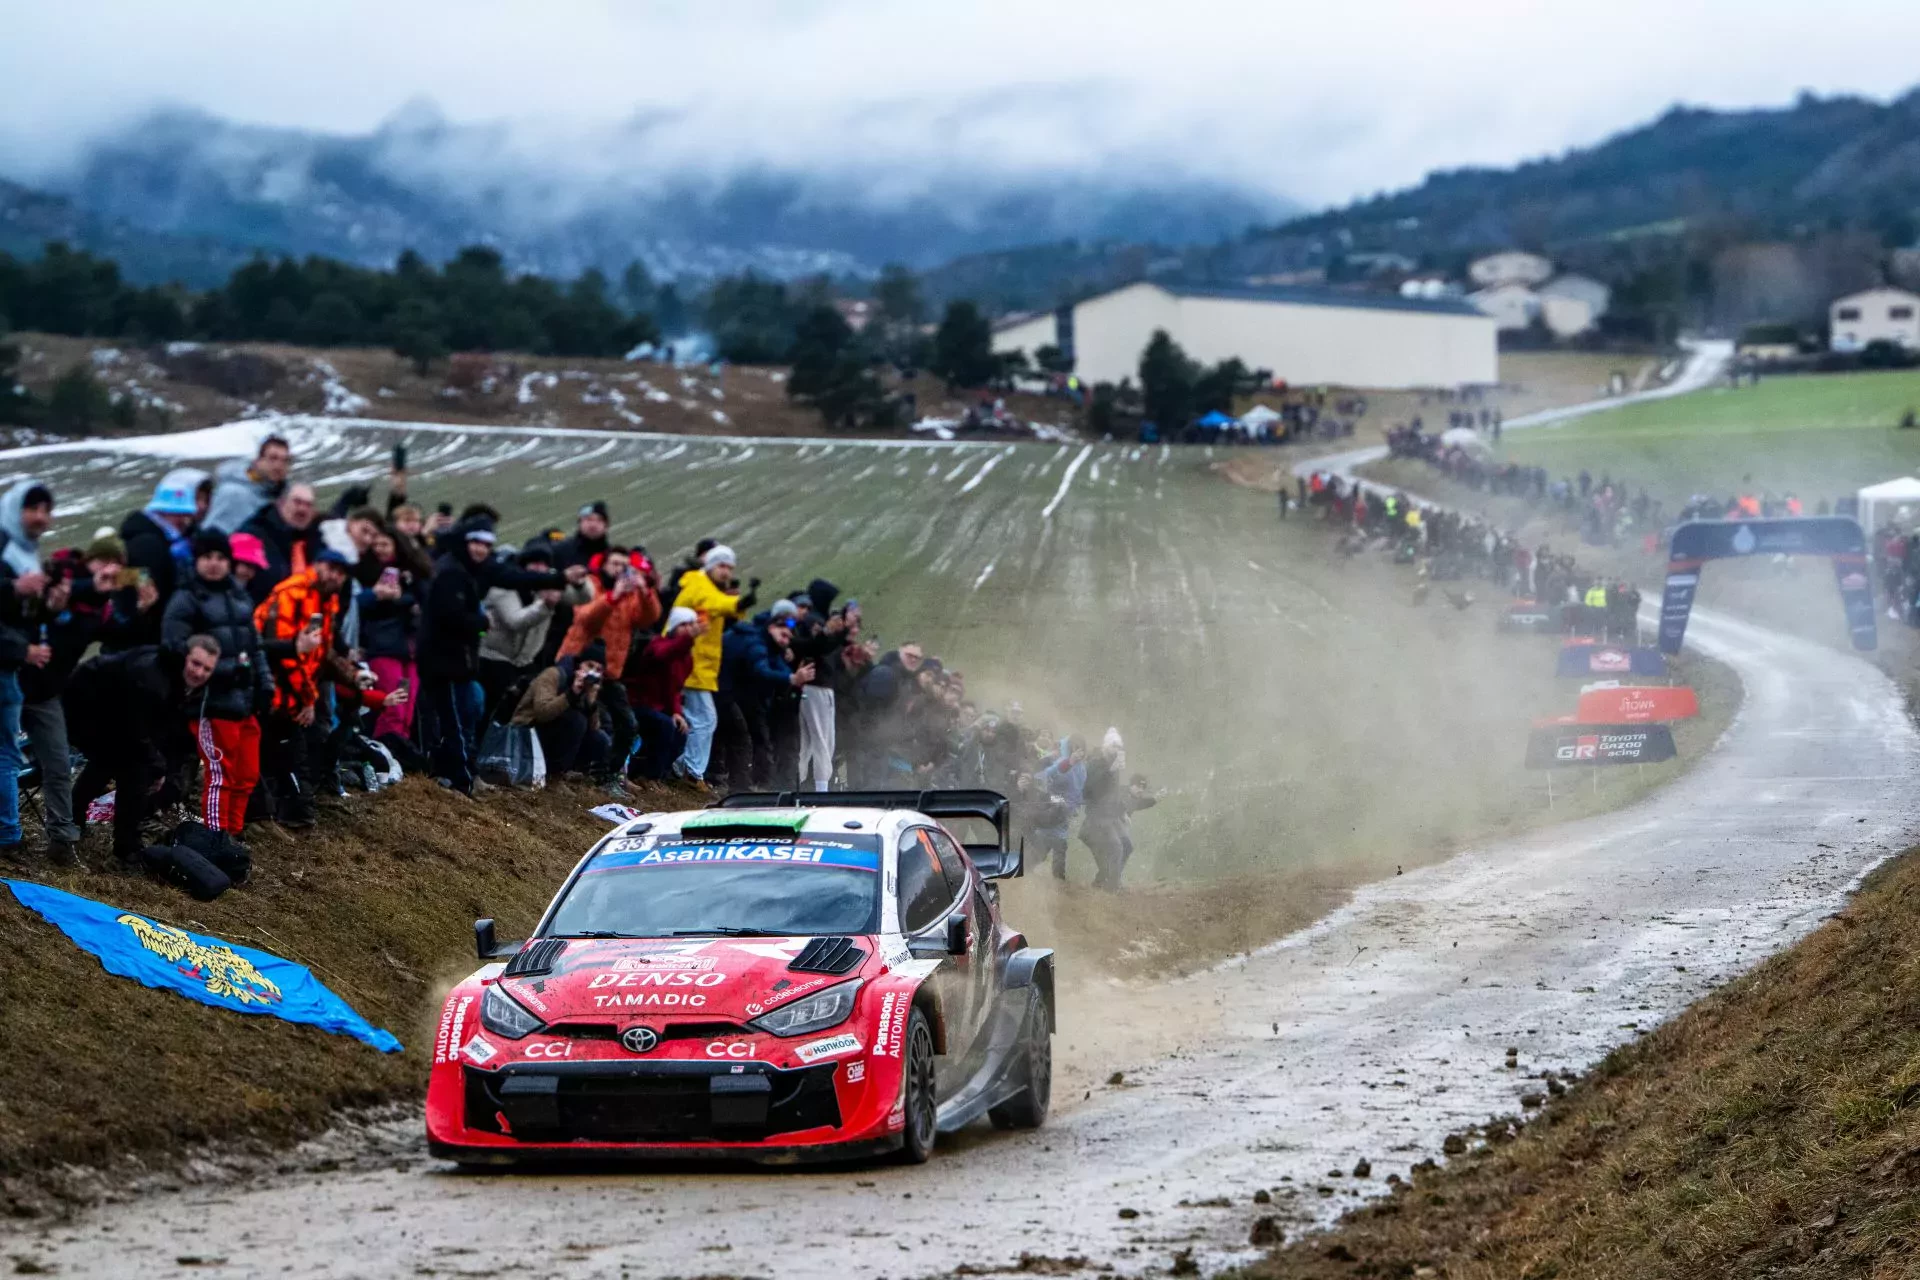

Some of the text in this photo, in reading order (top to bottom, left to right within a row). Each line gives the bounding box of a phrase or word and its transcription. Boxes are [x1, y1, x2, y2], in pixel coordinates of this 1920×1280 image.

[1601, 733, 1647, 742] TOYOTA
[1556, 745, 1597, 760] GR
[1600, 742, 1642, 750] GAZOO
[1601, 749, 1640, 758] acing
[613, 838, 647, 852] 33
[661, 838, 726, 847] TOYOTA
[730, 837, 793, 845] GAZOO
[587, 972, 727, 989] DENSO
[763, 978, 826, 1006] codebeamer
[593, 993, 707, 1008] TAMADIC
[435, 996, 459, 1064] AUTOMOTIVE
[449, 995, 474, 1061] Panasonic
[872, 991, 896, 1056] Panasonic
[889, 991, 910, 1058] AUTOMOTIVE
